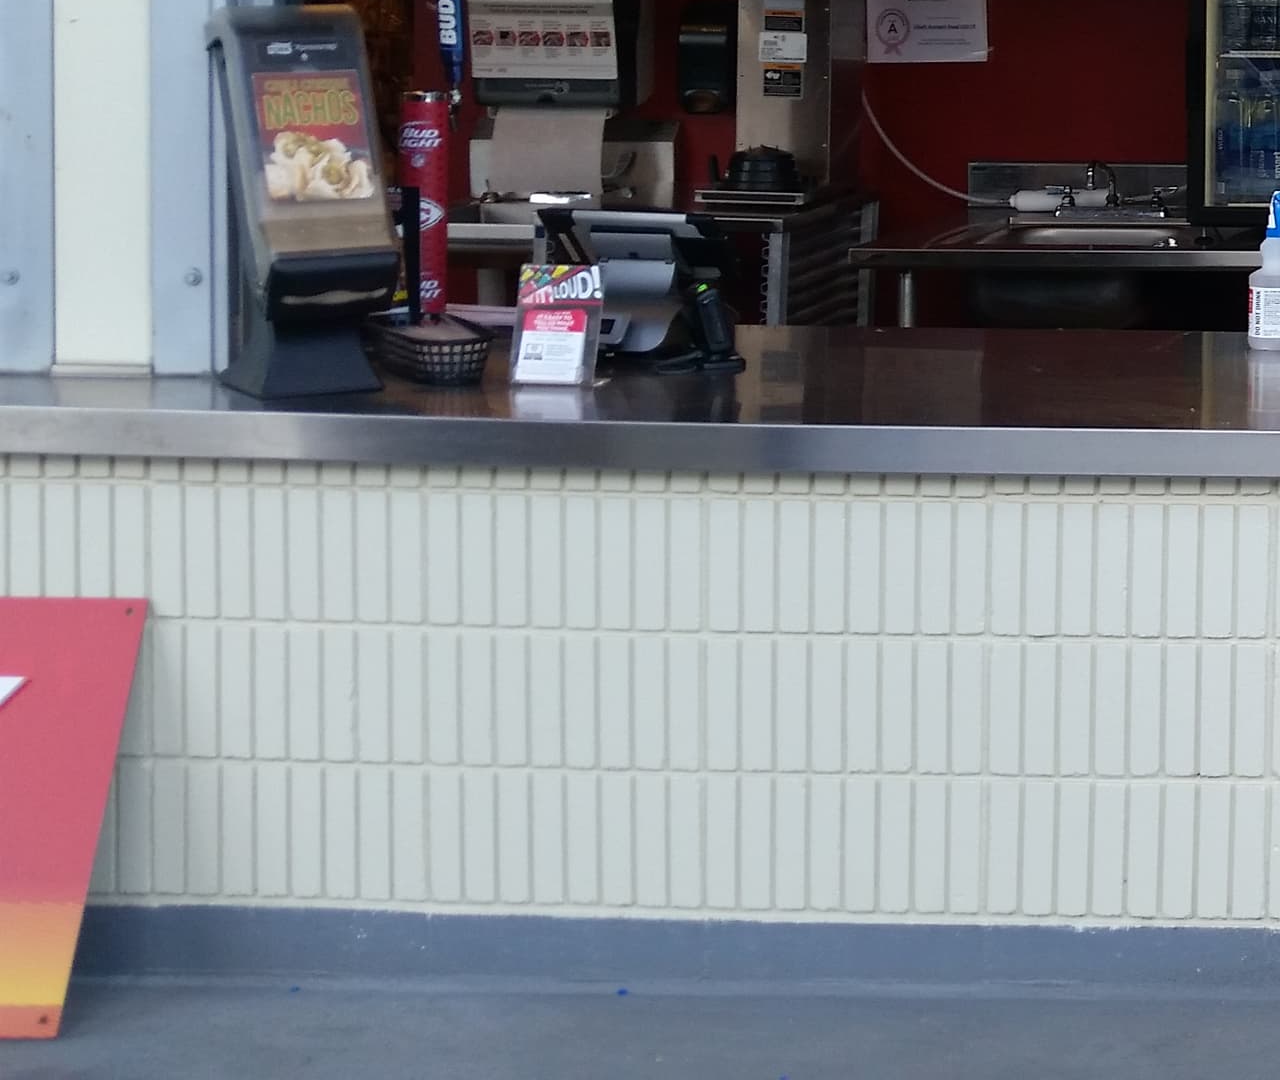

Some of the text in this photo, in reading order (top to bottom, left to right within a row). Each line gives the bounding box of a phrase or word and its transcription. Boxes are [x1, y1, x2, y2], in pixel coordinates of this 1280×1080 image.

[888, 23, 898, 34] A
[262, 89, 358, 130] NACHOS
[402, 127, 439, 138] BUD
[554, 265, 602, 299] LOUD!
